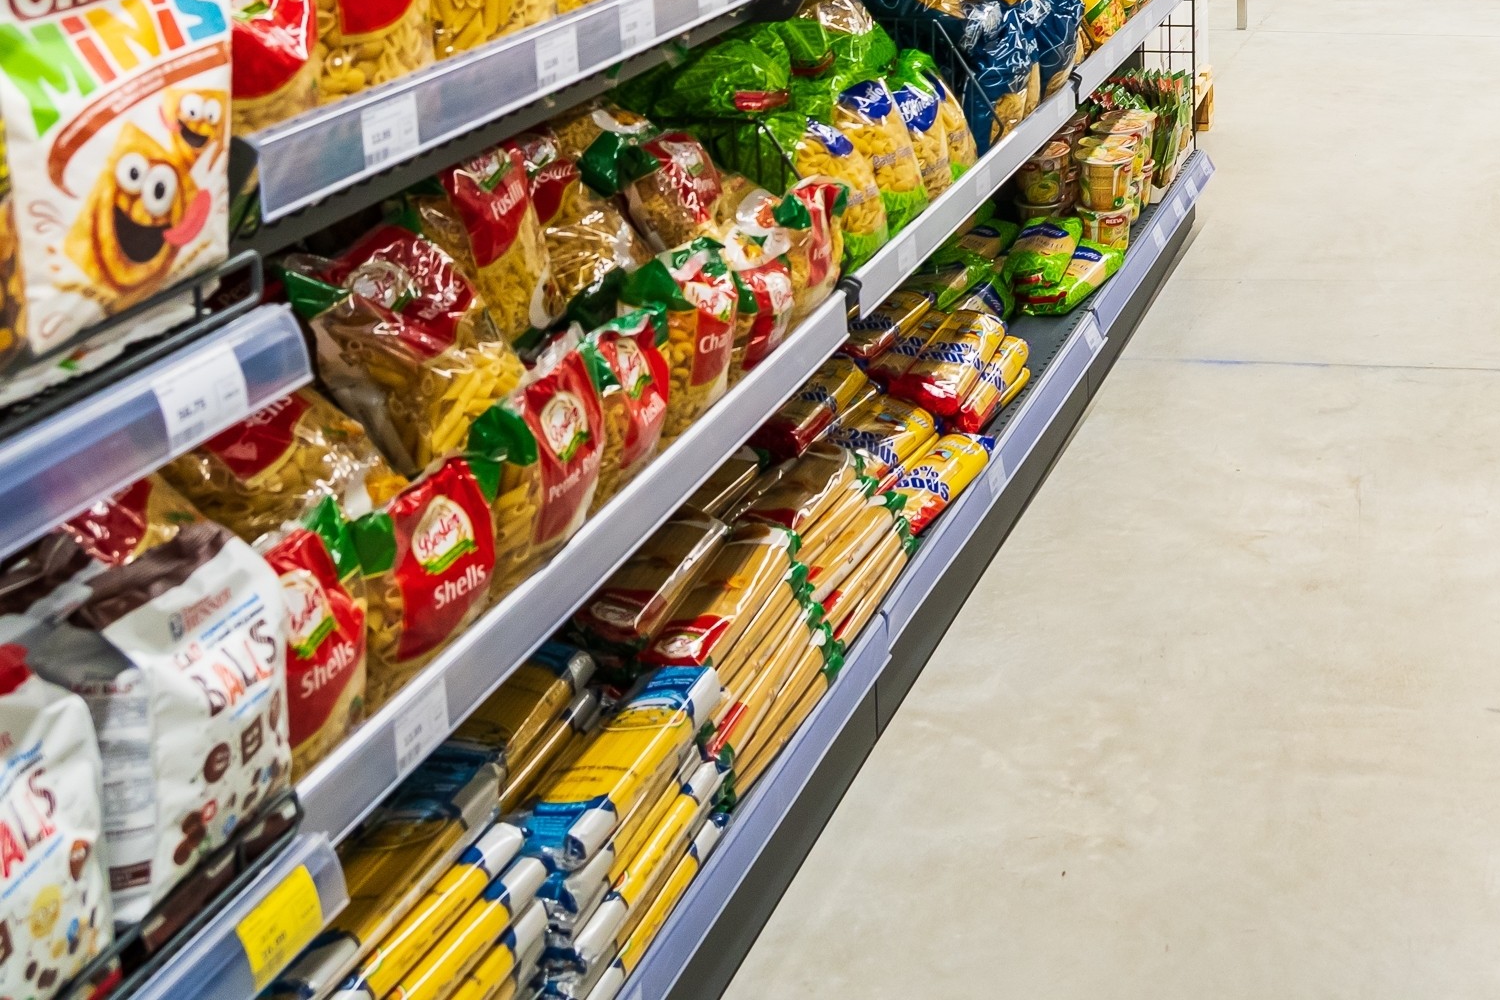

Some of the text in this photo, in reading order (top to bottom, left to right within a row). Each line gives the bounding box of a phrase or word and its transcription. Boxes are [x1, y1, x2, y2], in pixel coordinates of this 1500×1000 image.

[490, 179, 525, 222] Fusilli
[1105, 217, 1124, 226] REEVA
[433, 564, 487, 611] Shells
[301, 640, 356, 699] Shells
